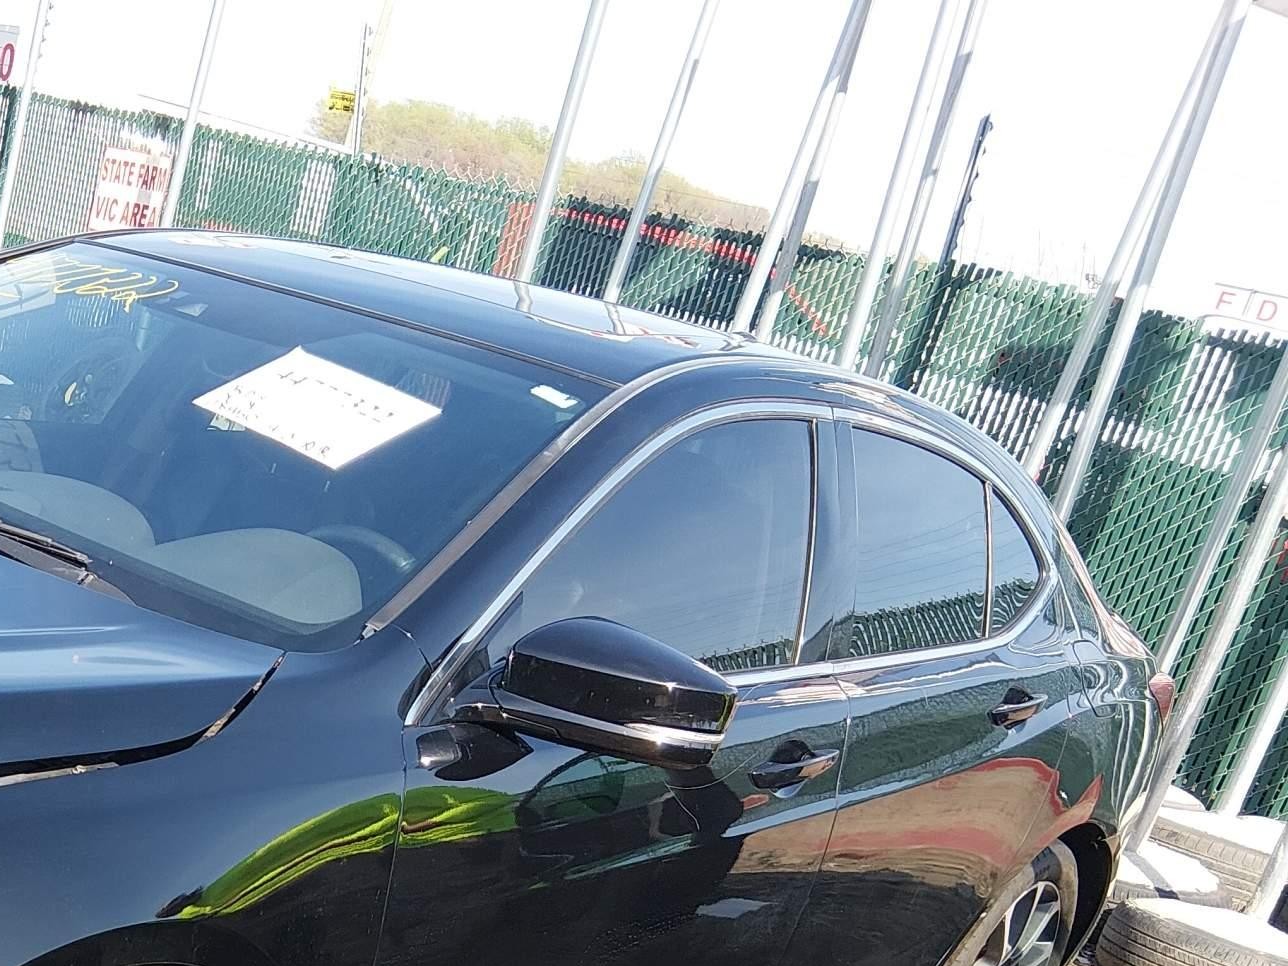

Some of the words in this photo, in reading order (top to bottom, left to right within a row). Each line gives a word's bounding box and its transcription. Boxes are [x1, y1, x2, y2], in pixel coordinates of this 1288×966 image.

[101, 157, 136, 187] STATE
[136, 163, 168, 193] FARM
[95, 195, 119, 222] VIC
[119, 200, 159, 228] AREA
